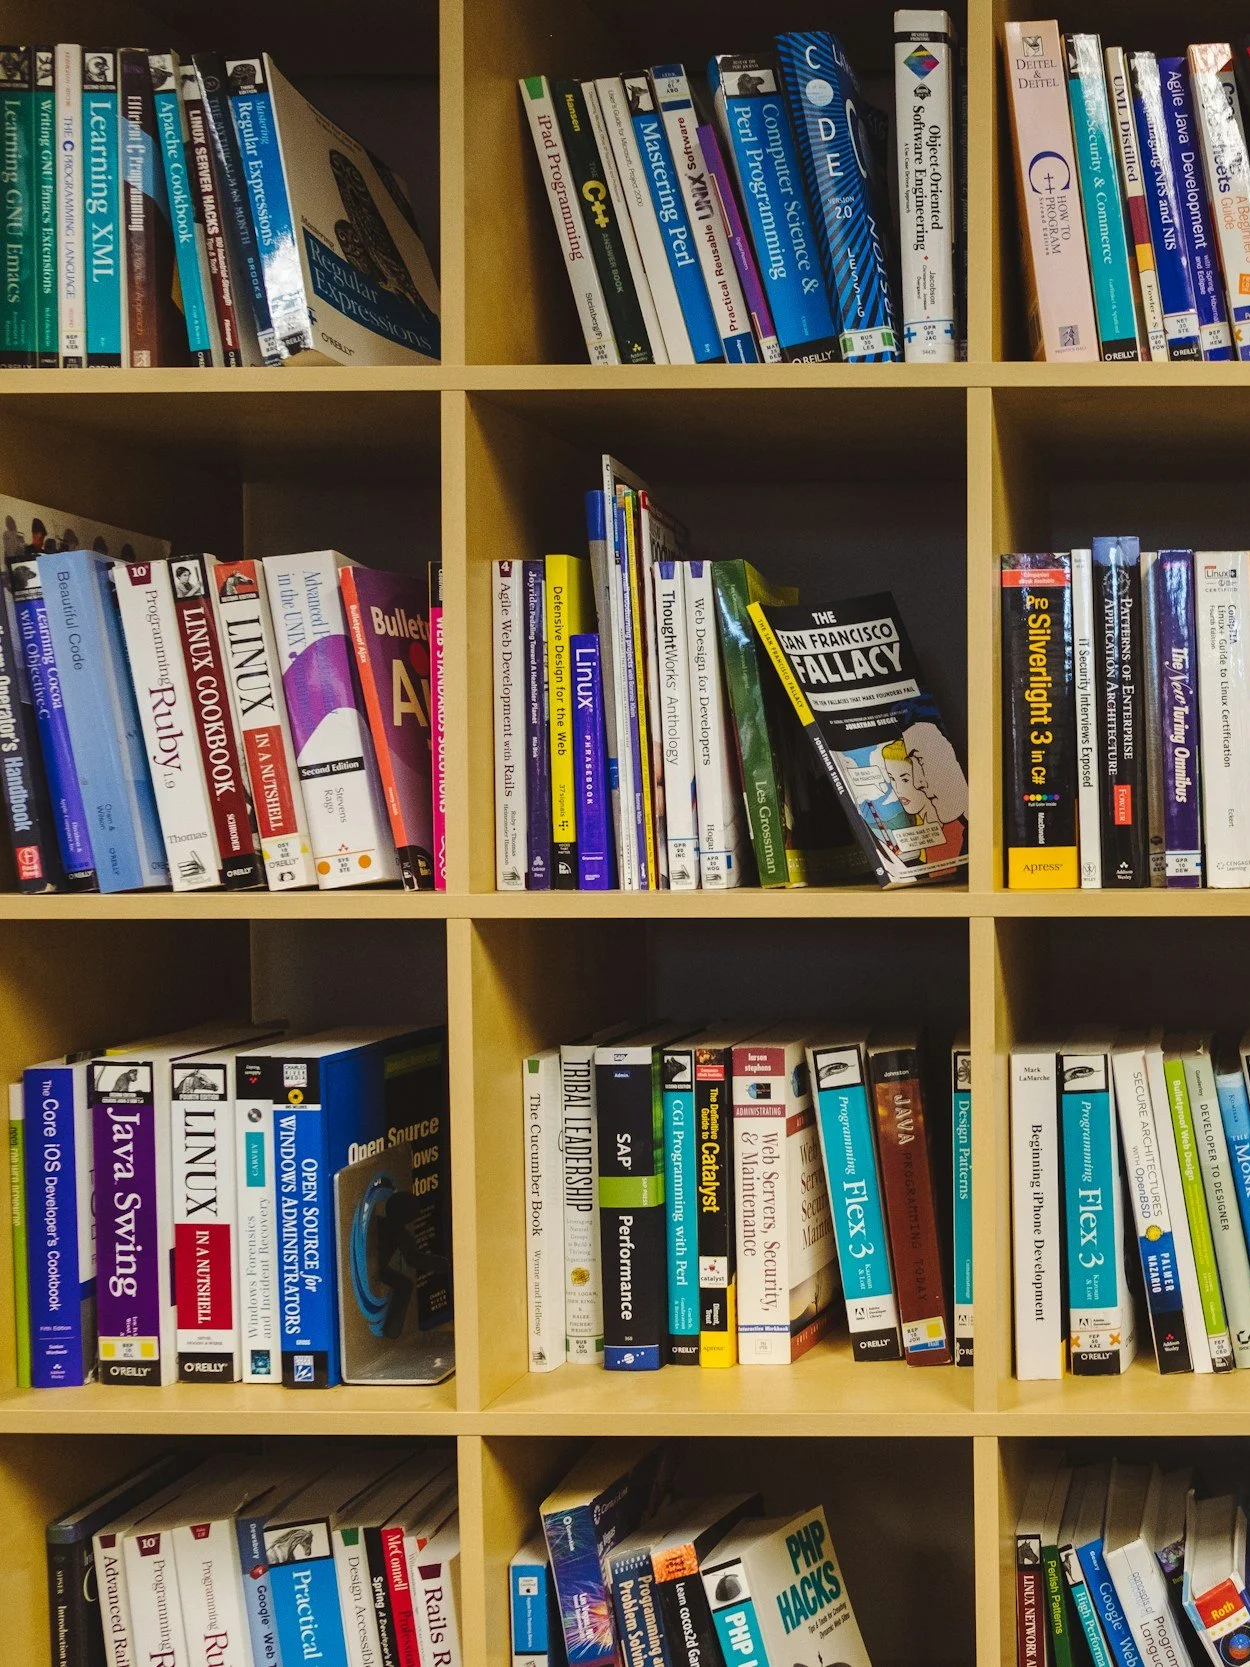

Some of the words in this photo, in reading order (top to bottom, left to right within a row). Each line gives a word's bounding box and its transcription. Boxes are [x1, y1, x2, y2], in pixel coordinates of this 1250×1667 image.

[39, 99, 53, 145] Writing
[159, 100, 182, 159] Apache
[537, 114, 558, 149] iPad
[913, 106, 927, 161] Software
[41, 150, 53, 180] GNU
[86, 100, 113, 214] Learning
[928, 125, 942, 230] Object-Oriented
[42, 185, 54, 223] Emacs
[170, 163, 192, 243] Cookbook
[546, 153, 584, 260] Programming
[640, 121, 679, 222] Mastering
[668, 228, 694, 267] Perl
[911, 166, 928, 250] Engineering
[43, 227, 55, 293] Extensions
[93, 223, 114, 282] XML
[553, 586, 564, 642] Defensive
[1026, 596, 1048, 610] Pro
[145, 590, 173, 687] Programming
[183, 608, 214, 671] LINUX
[225, 618, 274, 717] LINUX
[553, 645, 565, 684] Design
[576, 648, 598, 708] Linux
[790, 645, 902, 683] FALLACY
[1026, 614, 1052, 725] Silverlight
[556, 687, 566, 702] for
[556, 706, 566, 727] the
[148, 685, 183, 771] Ruby
[197, 677, 235, 796] COOKBOOK
[255, 733, 269, 747] IN
[557, 732, 566, 755] Web
[1031, 730, 1050, 745] 3
[258, 750, 271, 761] A
[1031, 767, 1046, 784] C#
[1032, 751, 1044, 763] in
[164, 772, 176, 789] 1.9
[261, 765, 283, 831] NUTSHELL
[755, 781, 769, 803] Les
[227, 813, 241, 851] SCHRODER
[758, 807, 777, 873] Grossman
[42, 1080, 51, 1096] The
[530, 1093, 542, 1119] The
[43, 1099, 58, 1137] Core
[673, 1100, 686, 1126] CGI
[45, 1143, 61, 1172] iOS
[107, 1108, 141, 1180] Java
[183, 1109, 217, 1217] LINUX
[531, 1123, 542, 1197] Cucumber
[617, 1134, 632, 1166] SAP
[1030, 1124, 1045, 1187] Beginning
[668, 1131, 686, 1221] Programming
[44, 1177, 59, 1246] Developer's
[531, 1202, 543, 1236] Book
[1032, 1191, 1045, 1235] iPhone
[110, 1192, 141, 1297] Swing
[674, 1226, 687, 1255] with
[47, 1251, 61, 1311] Cookbook
[619, 1215, 634, 1320] Performance
[674, 1260, 687, 1286] Perl
[1032, 1240, 1047, 1321] Development
[184, 1363, 227, 1372] O'REILLY
[250, 1524, 259, 1558] Dewsbury
[387, 1535, 407, 1591] McConnell
[785, 1520, 826, 1576] PHP
[103, 1556, 122, 1632] Advanced
[675, 1582, 689, 1605] Learn
[776, 1561, 841, 1635] HACKS
[1046, 1560, 1059, 1596] Perlish
[292, 1570, 321, 1659] Practical
[424, 1587, 446, 1644] Rails
[678, 1607, 698, 1648] cocos2d
[1048, 1597, 1064, 1634] Patterns
[1097, 1583, 1121, 1630] Google
[1210, 1607, 1234, 1622] Roth
[724, 1613, 754, 1654] PHP
